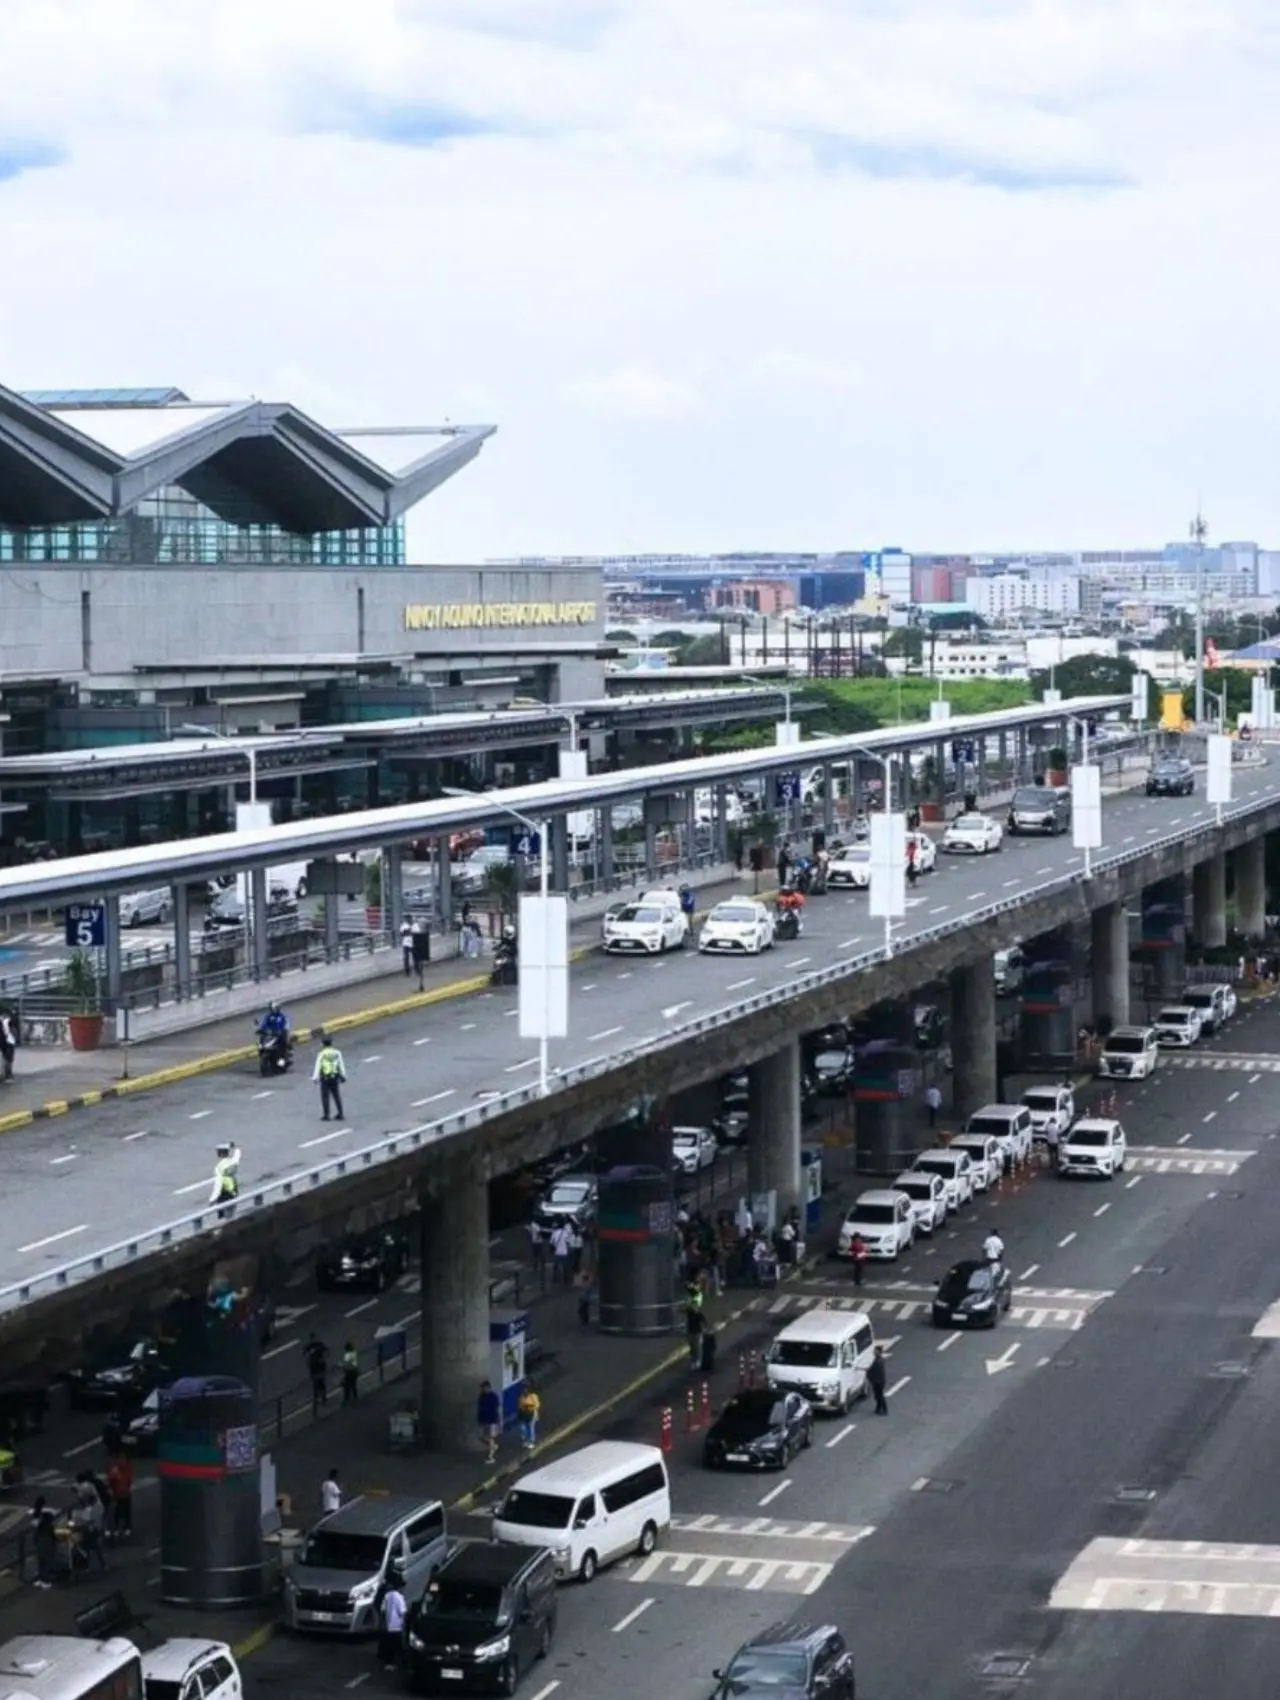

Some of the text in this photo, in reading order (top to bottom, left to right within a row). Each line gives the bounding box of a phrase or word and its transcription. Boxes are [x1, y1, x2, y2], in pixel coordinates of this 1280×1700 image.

[782, 784, 792, 800] 3
[519, 836, 530, 854] 4
[70, 906, 99, 922] Bay
[78, 921, 92, 945] 5
